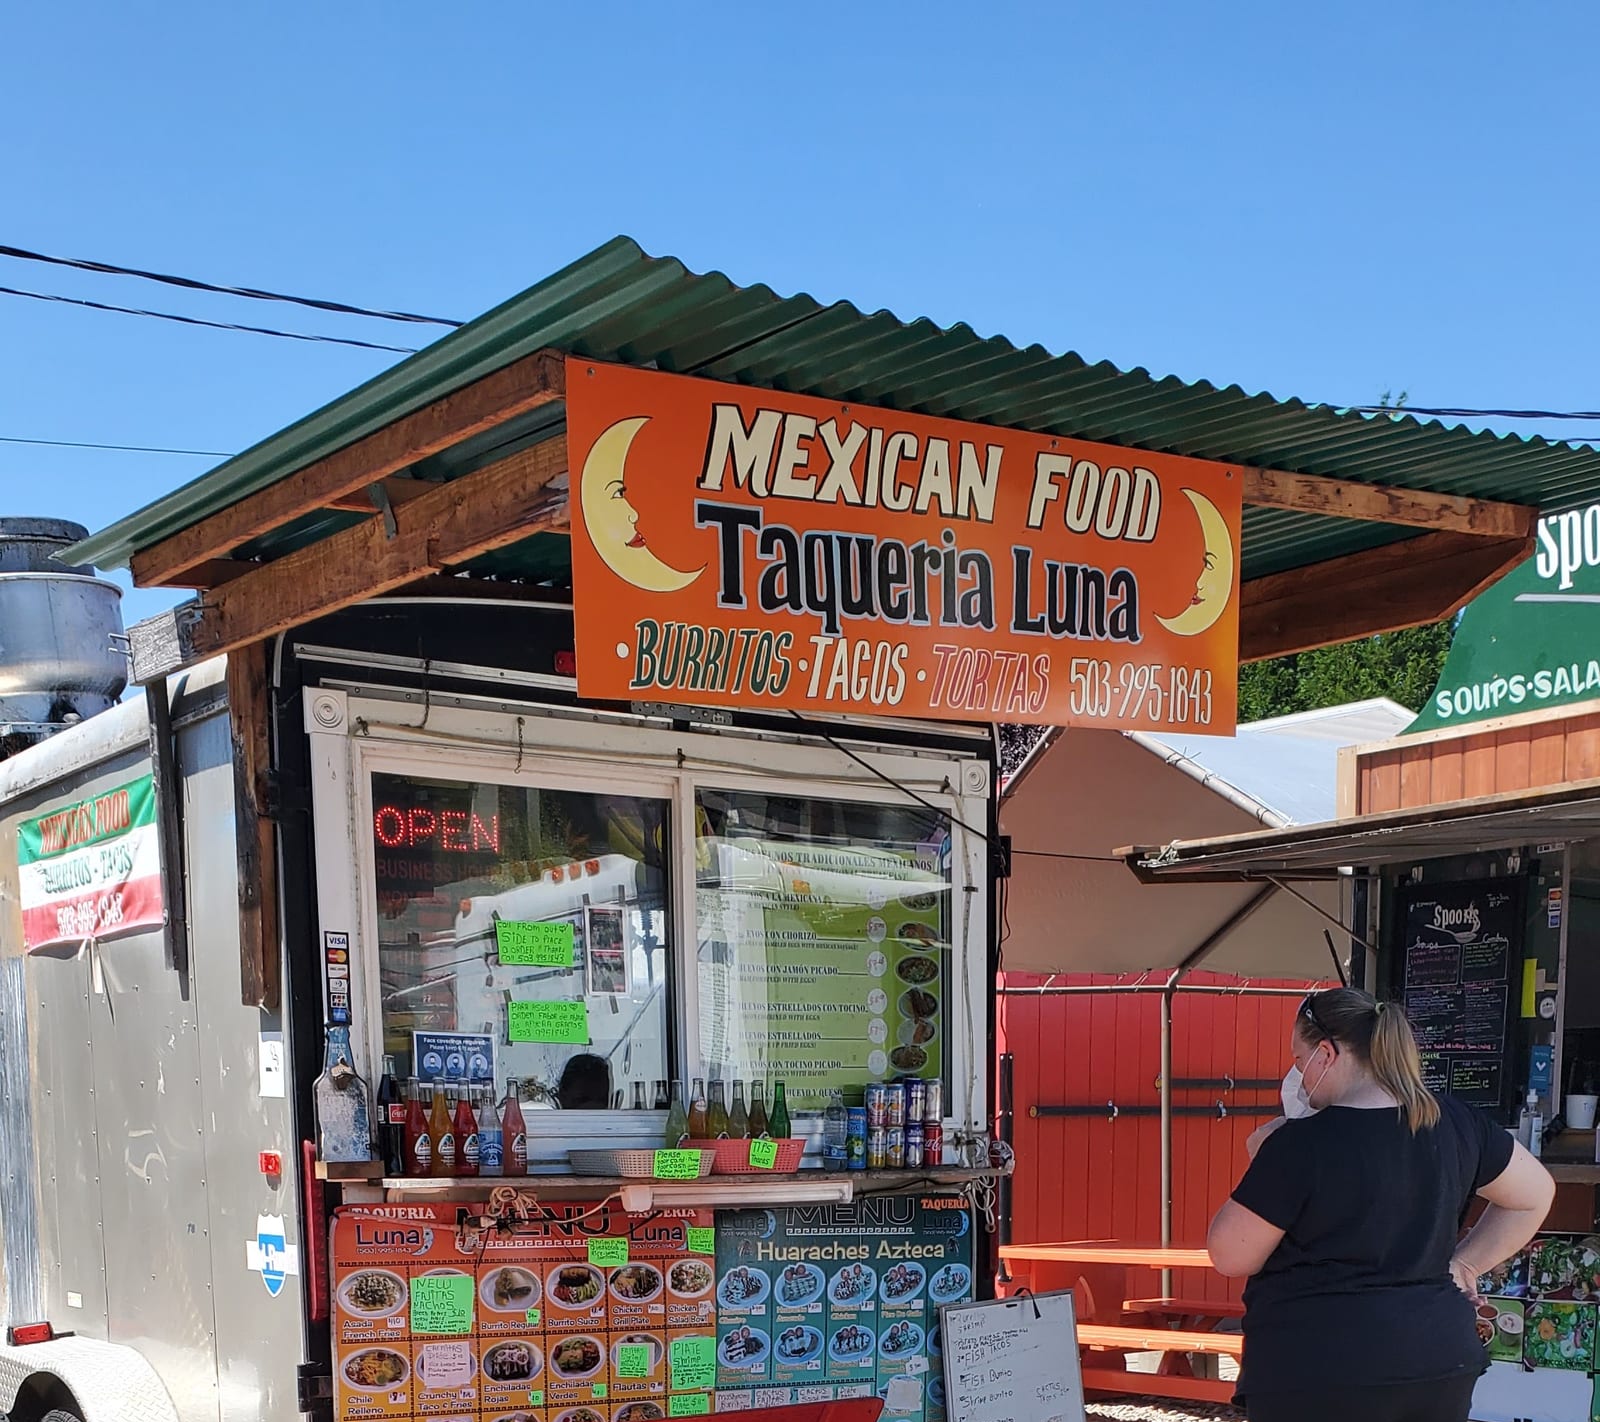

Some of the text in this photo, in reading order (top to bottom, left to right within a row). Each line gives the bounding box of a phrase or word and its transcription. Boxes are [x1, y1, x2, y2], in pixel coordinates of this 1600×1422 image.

[697, 403, 1162, 544] MEXICAN FOOD
[695, 499, 1145, 645] Taqueria Luna
[629, 619, 1213, 725] BURRITOS TACOS TORTAS 503-995-1843
[38, 790, 131, 854] MEXICAN FOOD
[375, 807, 499, 854] OPEN
[329, 937, 347, 945] VISA
[781, 932, 817, 941] CHORIZO
[810, 966, 838, 976] PICADO
[767, 1002, 822, 1012] ESTRELLADOS
[767, 1031, 821, 1041] ESTRELLADOS
[784, 1060, 813, 1069] TOCINO
[814, 1060, 841, 1070] PICADO
[920, 1197, 969, 1210] TAQUERIA
[355, 1223, 420, 1246] Luna
[630, 1222, 683, 1242] Luna
[756, 1239, 945, 1261] Huaraches Azteca
[613, 1305, 643, 1314] Chicken
[668, 1304, 698, 1313] Chicken
[343, 1320, 373, 1328] Asada
[548, 1319, 575, 1327] Burrito
[630, 1316, 650, 1325] Plate
[481, 1322, 509, 1330] Burrito
[343, 1331, 376, 1339] French
[484, 1382, 531, 1393] Enchiladas
[549, 1380, 595, 1390] Enchiladas
[612, 1382, 647, 1391] Flautas
[347, 1396, 373, 1405] Chile
[417, 1391, 457, 1401] Crunchy
[484, 1394, 509, 1403] Rojas
[549, 1392, 578, 1401] Verdes
[348, 1406, 384, 1416] Relleno
[418, 1402, 440, 1411] Taco
